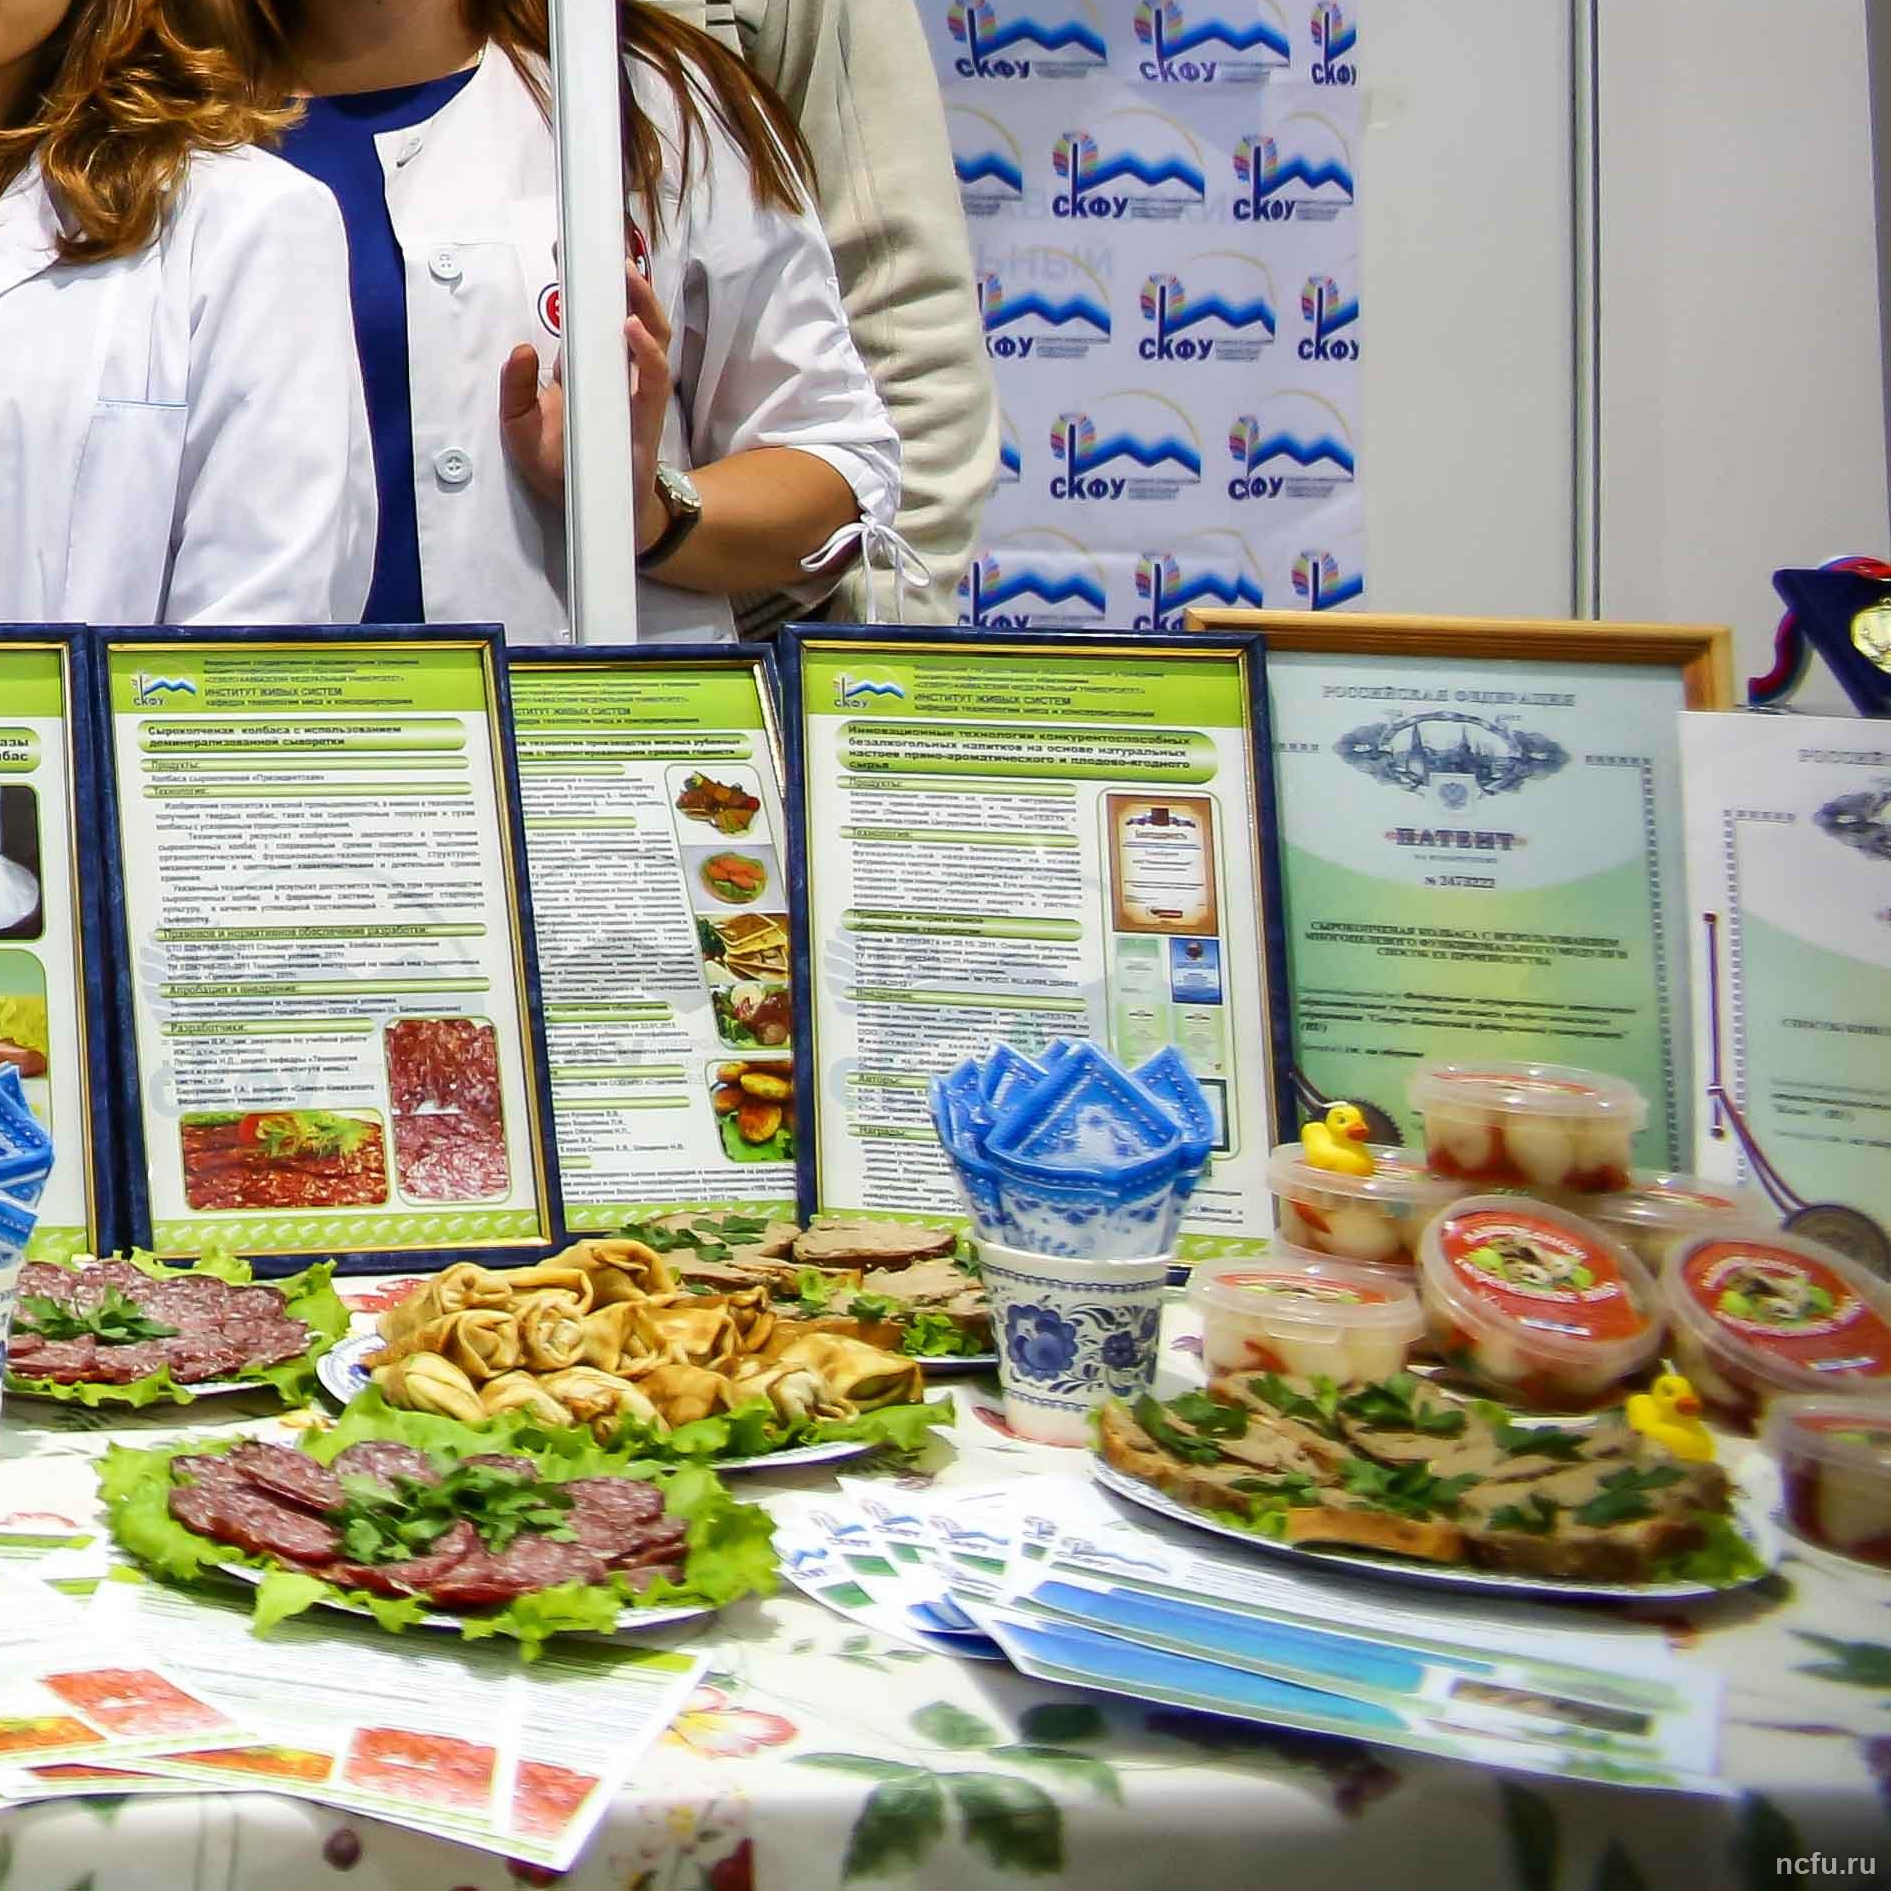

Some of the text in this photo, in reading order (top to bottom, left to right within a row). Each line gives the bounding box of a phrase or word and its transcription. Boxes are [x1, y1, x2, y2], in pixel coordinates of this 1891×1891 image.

[956, 57, 1030, 80] СКФУ
[1140, 58, 1217, 84] СКФУ
[1053, 194, 1128, 220] СКФУ
[1233, 197, 1295, 221] СКФУ
[1138, 336, 1213, 362] СКФУ
[1050, 474, 1125, 500] СКФУ
